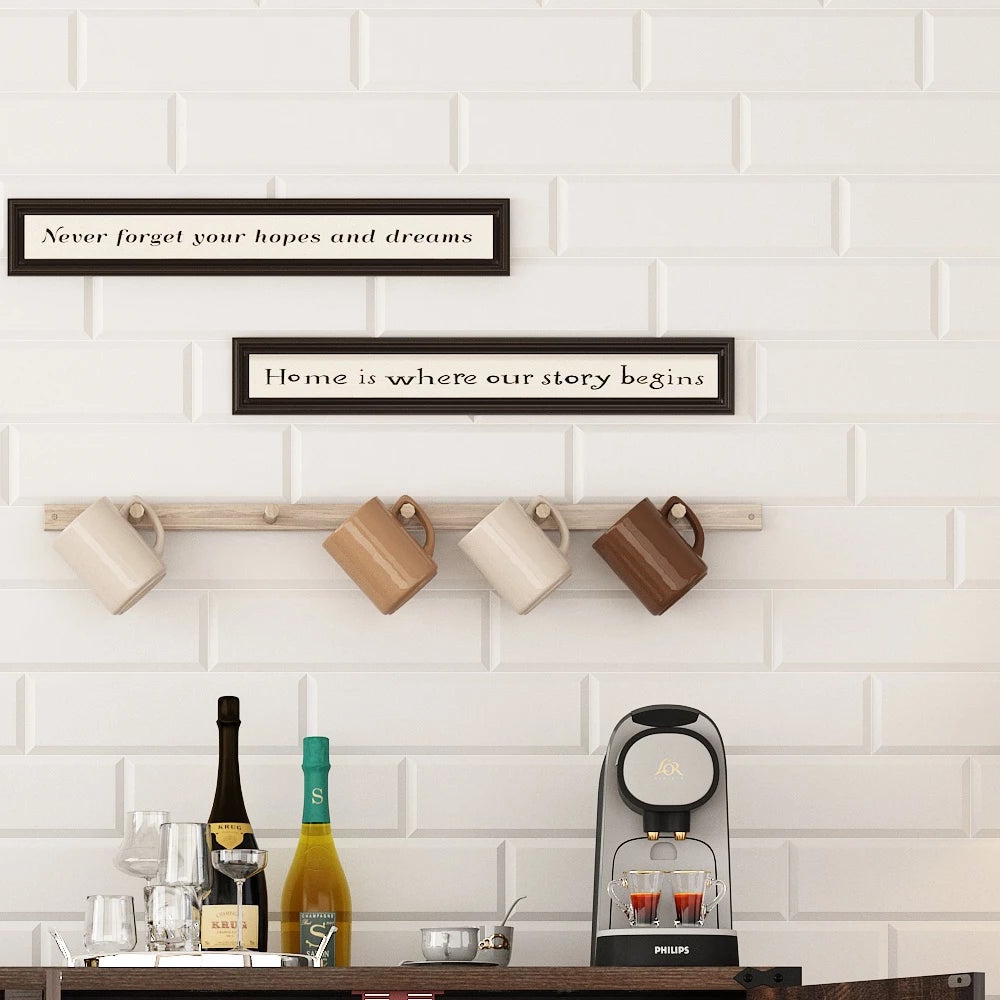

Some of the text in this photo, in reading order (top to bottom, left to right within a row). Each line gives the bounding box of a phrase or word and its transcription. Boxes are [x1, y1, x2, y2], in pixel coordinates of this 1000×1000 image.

[42, 226, 473, 246] Never forget your hopes and dreams
[264, 365, 705, 390] Home is where our story begins
[312, 788, 324, 804] S
[654, 946, 689, 954] PHILIPS
